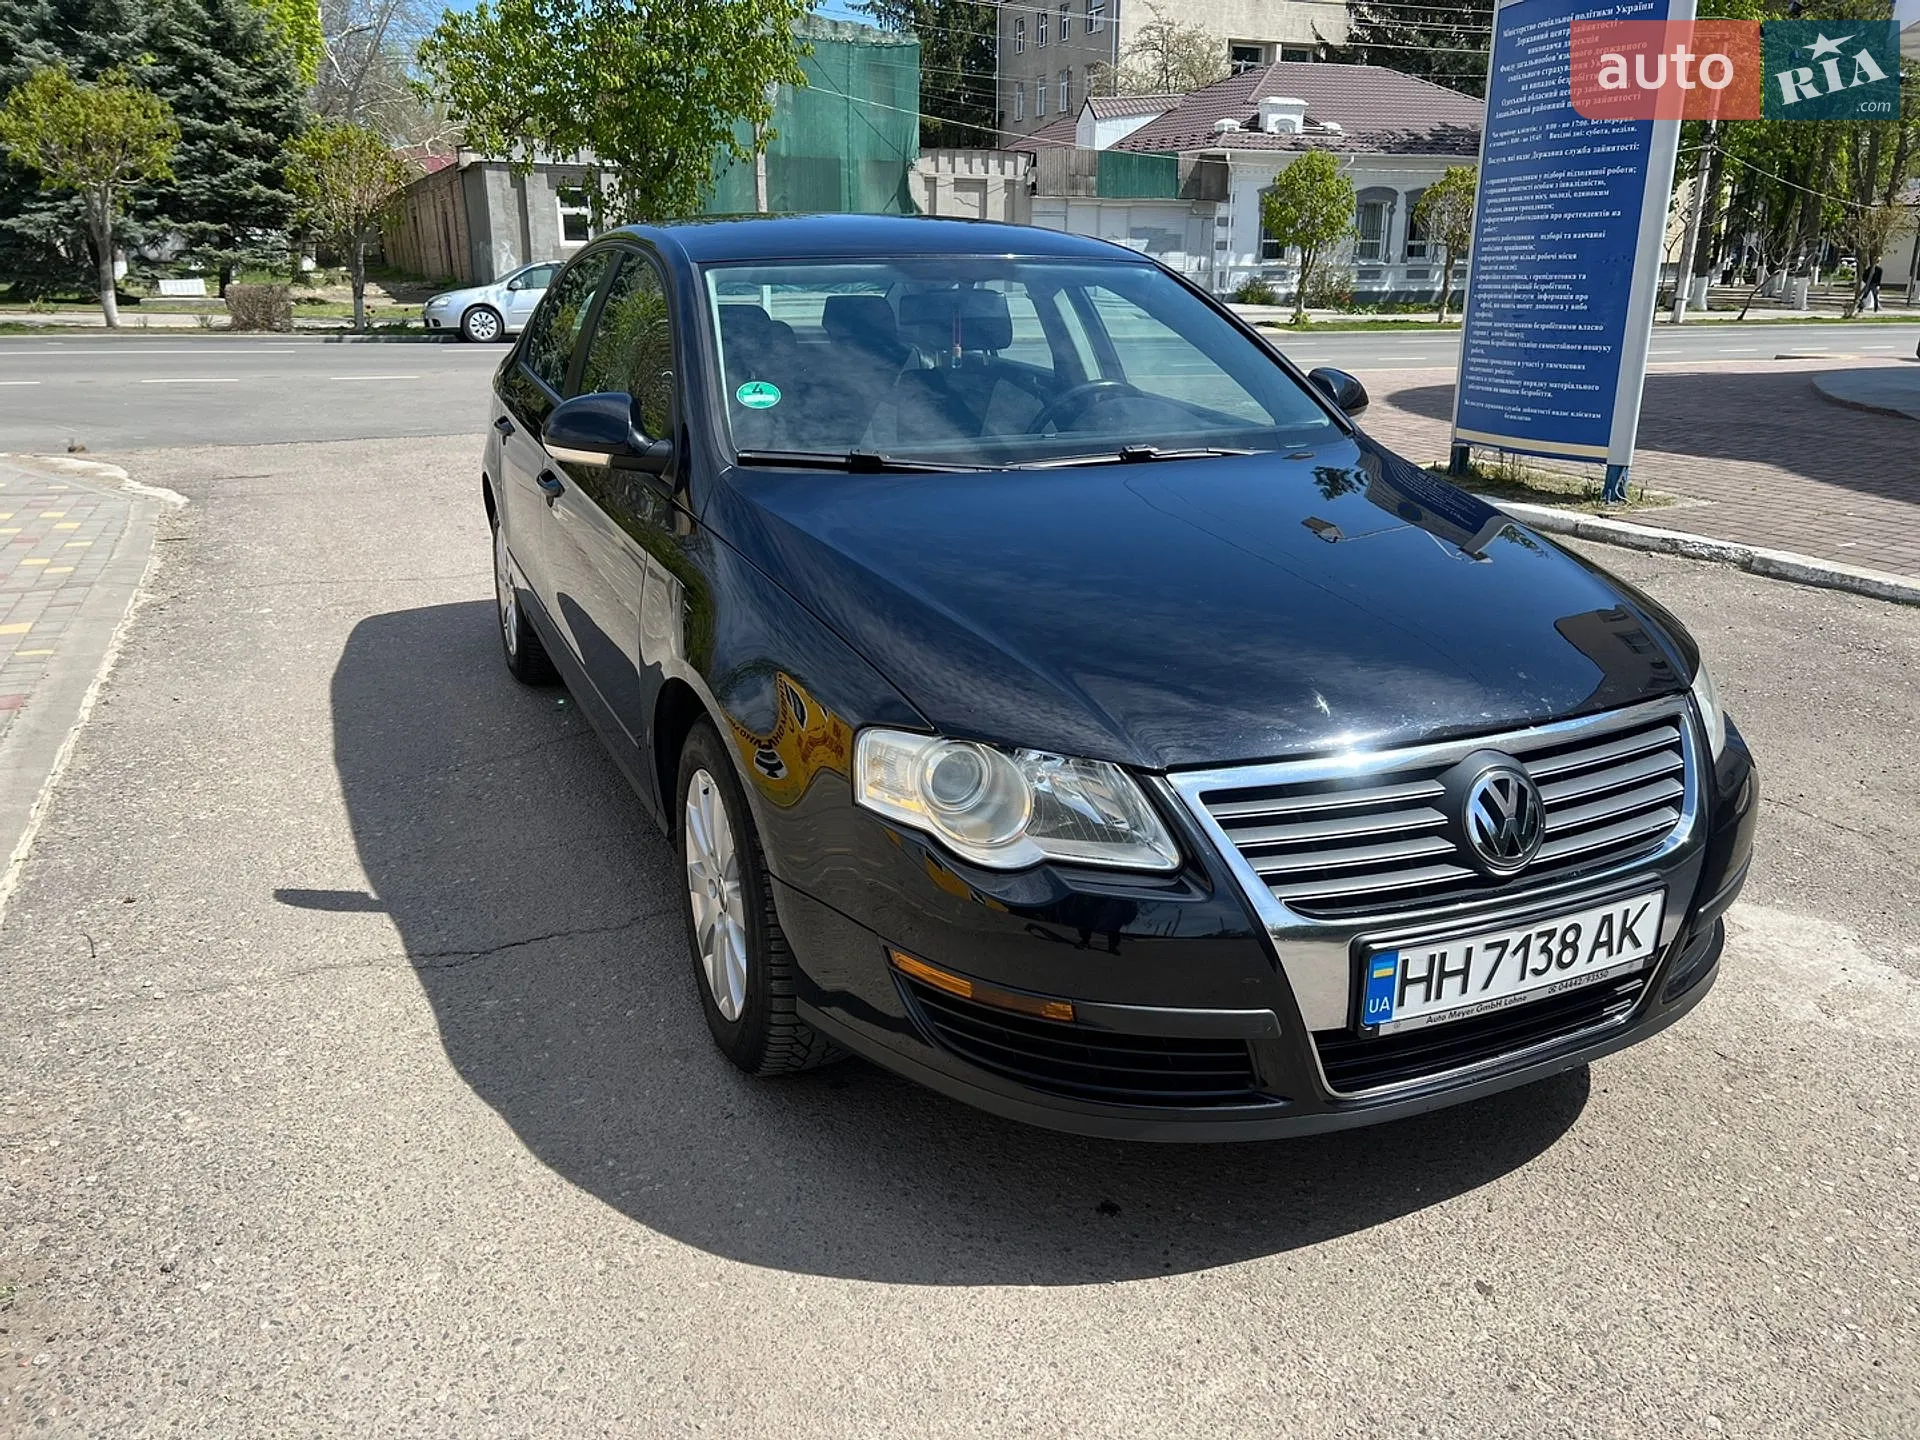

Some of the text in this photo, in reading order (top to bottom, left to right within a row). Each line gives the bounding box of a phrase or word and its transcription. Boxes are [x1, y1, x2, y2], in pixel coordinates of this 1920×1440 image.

[1574, 8, 1613, 22] політики
[1615, 2, 1654, 17] України
[1397, 901, 1651, 1008] HH 7138 AK
[1369, 996, 1391, 1014] UA
[1426, 1014, 1447, 1025] Auto
[1448, 1008, 1475, 1020] Meyer
[1476, 1001, 1503, 1014] GmbH
